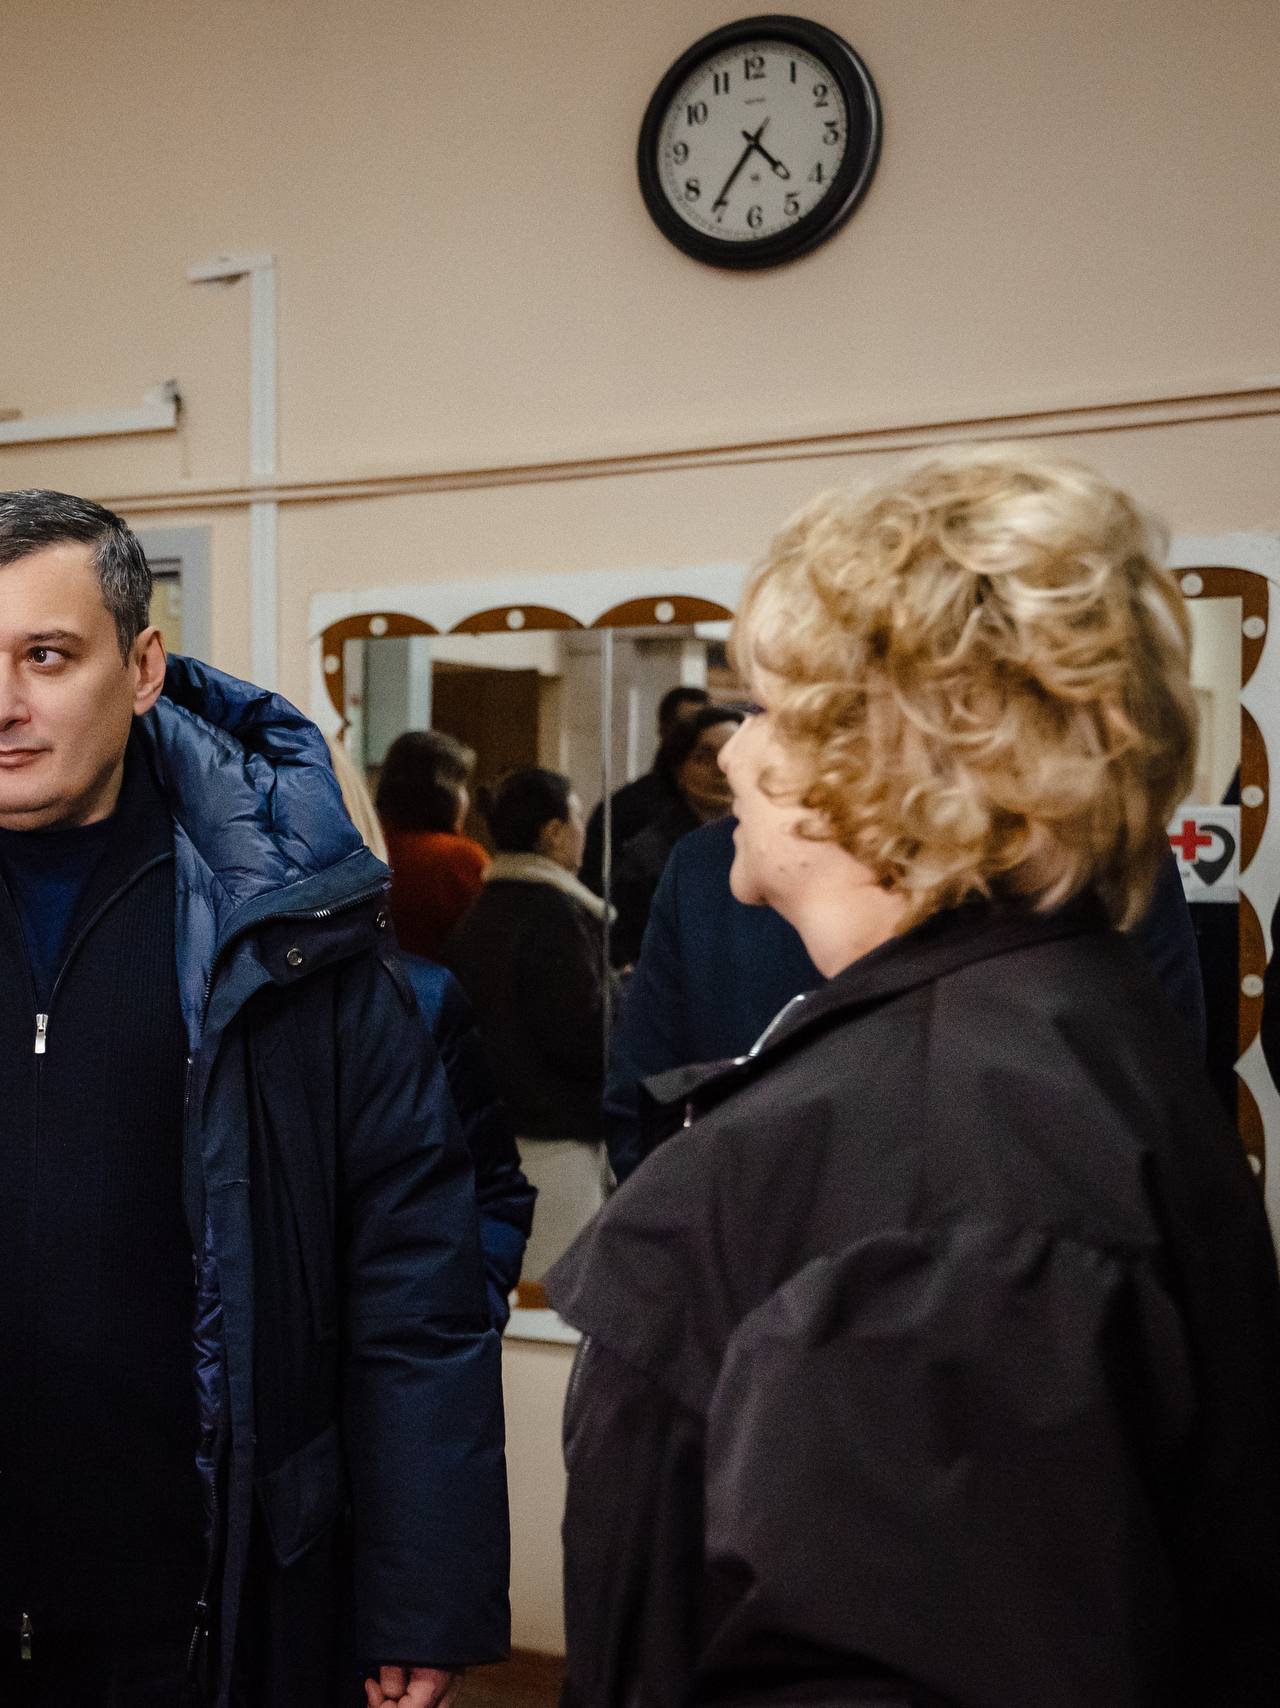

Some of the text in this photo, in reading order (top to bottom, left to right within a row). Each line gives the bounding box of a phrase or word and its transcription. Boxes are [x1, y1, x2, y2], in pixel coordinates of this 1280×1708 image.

[744, 56, 766, 80] 12
[790, 61, 796, 84] 1
[714, 71, 729, 95] 11
[813, 84, 829, 108] 2
[687, 103, 708, 126] 10
[823, 120, 839, 146] 3
[673, 142, 688, 165] 9
[808, 162, 825, 184] 4
[685, 178, 701, 202] 8
[715, 199, 728, 223] 7
[784, 192, 800, 216] 5
[747, 205, 763, 229] 6
